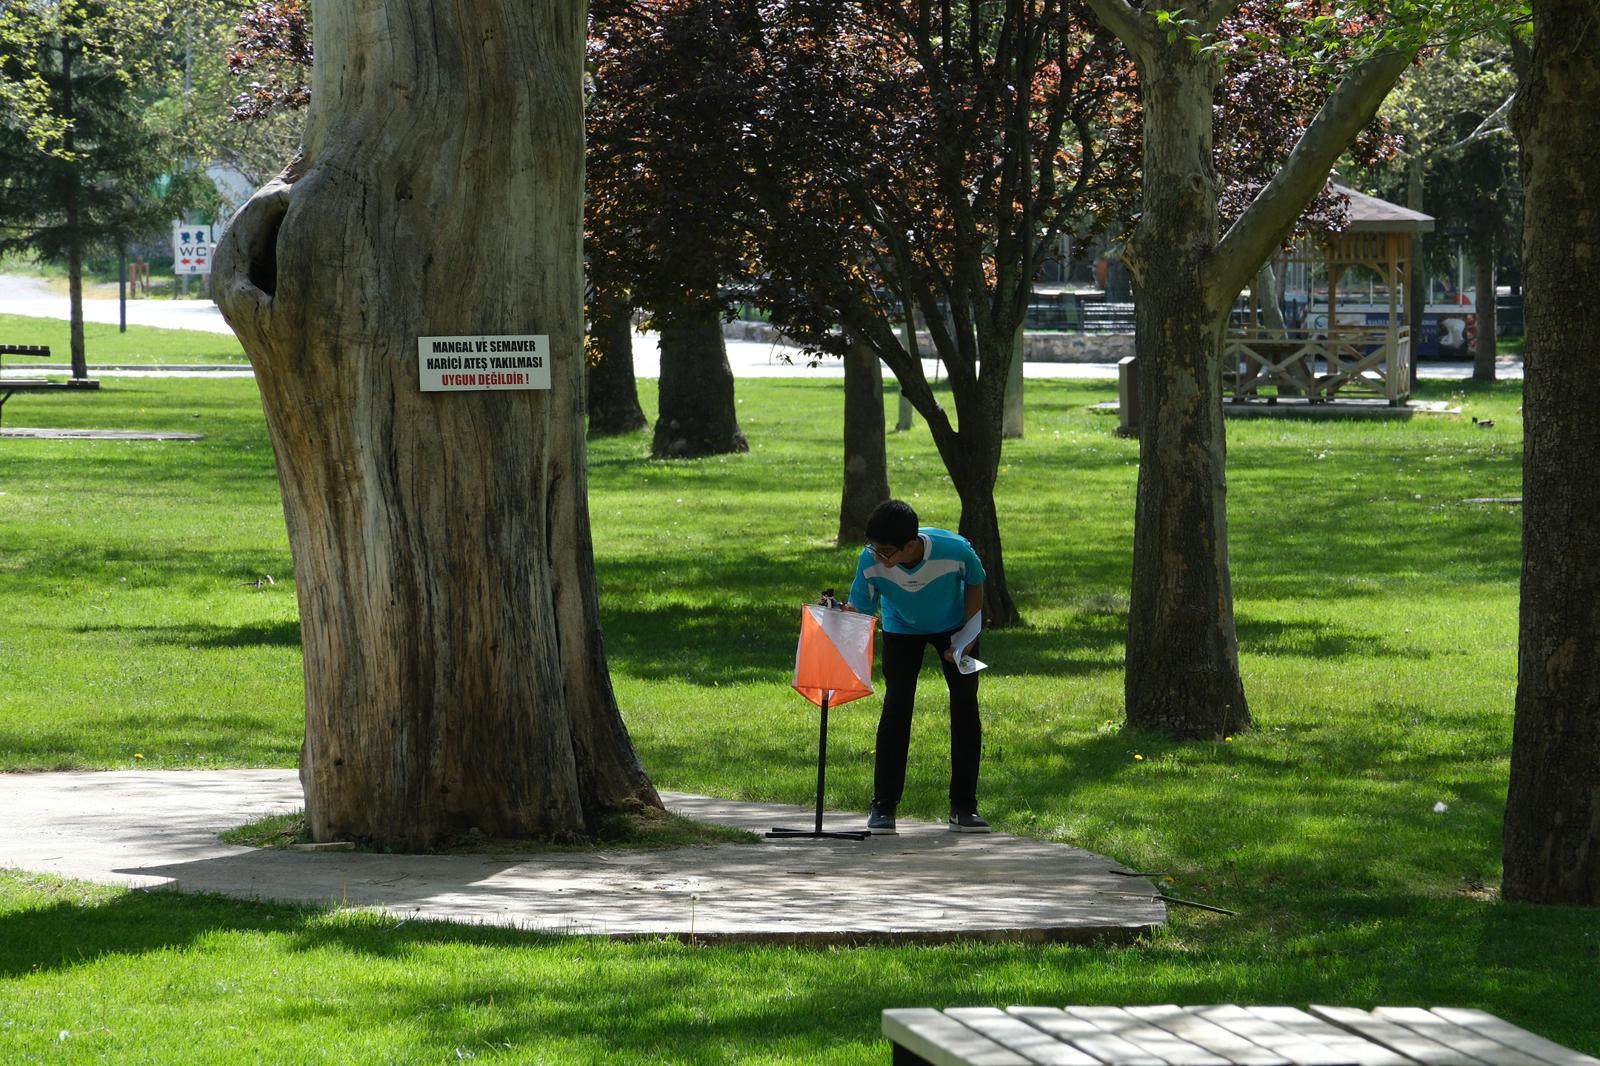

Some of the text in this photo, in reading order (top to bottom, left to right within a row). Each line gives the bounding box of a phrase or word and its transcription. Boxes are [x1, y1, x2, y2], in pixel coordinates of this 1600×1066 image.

[179, 246, 207, 257] WC
[433, 340, 536, 353] MANGAL VE SEMAVER
[427, 356, 543, 371] HARİCİ ATEŞ YAKILMASI
[442, 374, 476, 386] UYGUN
